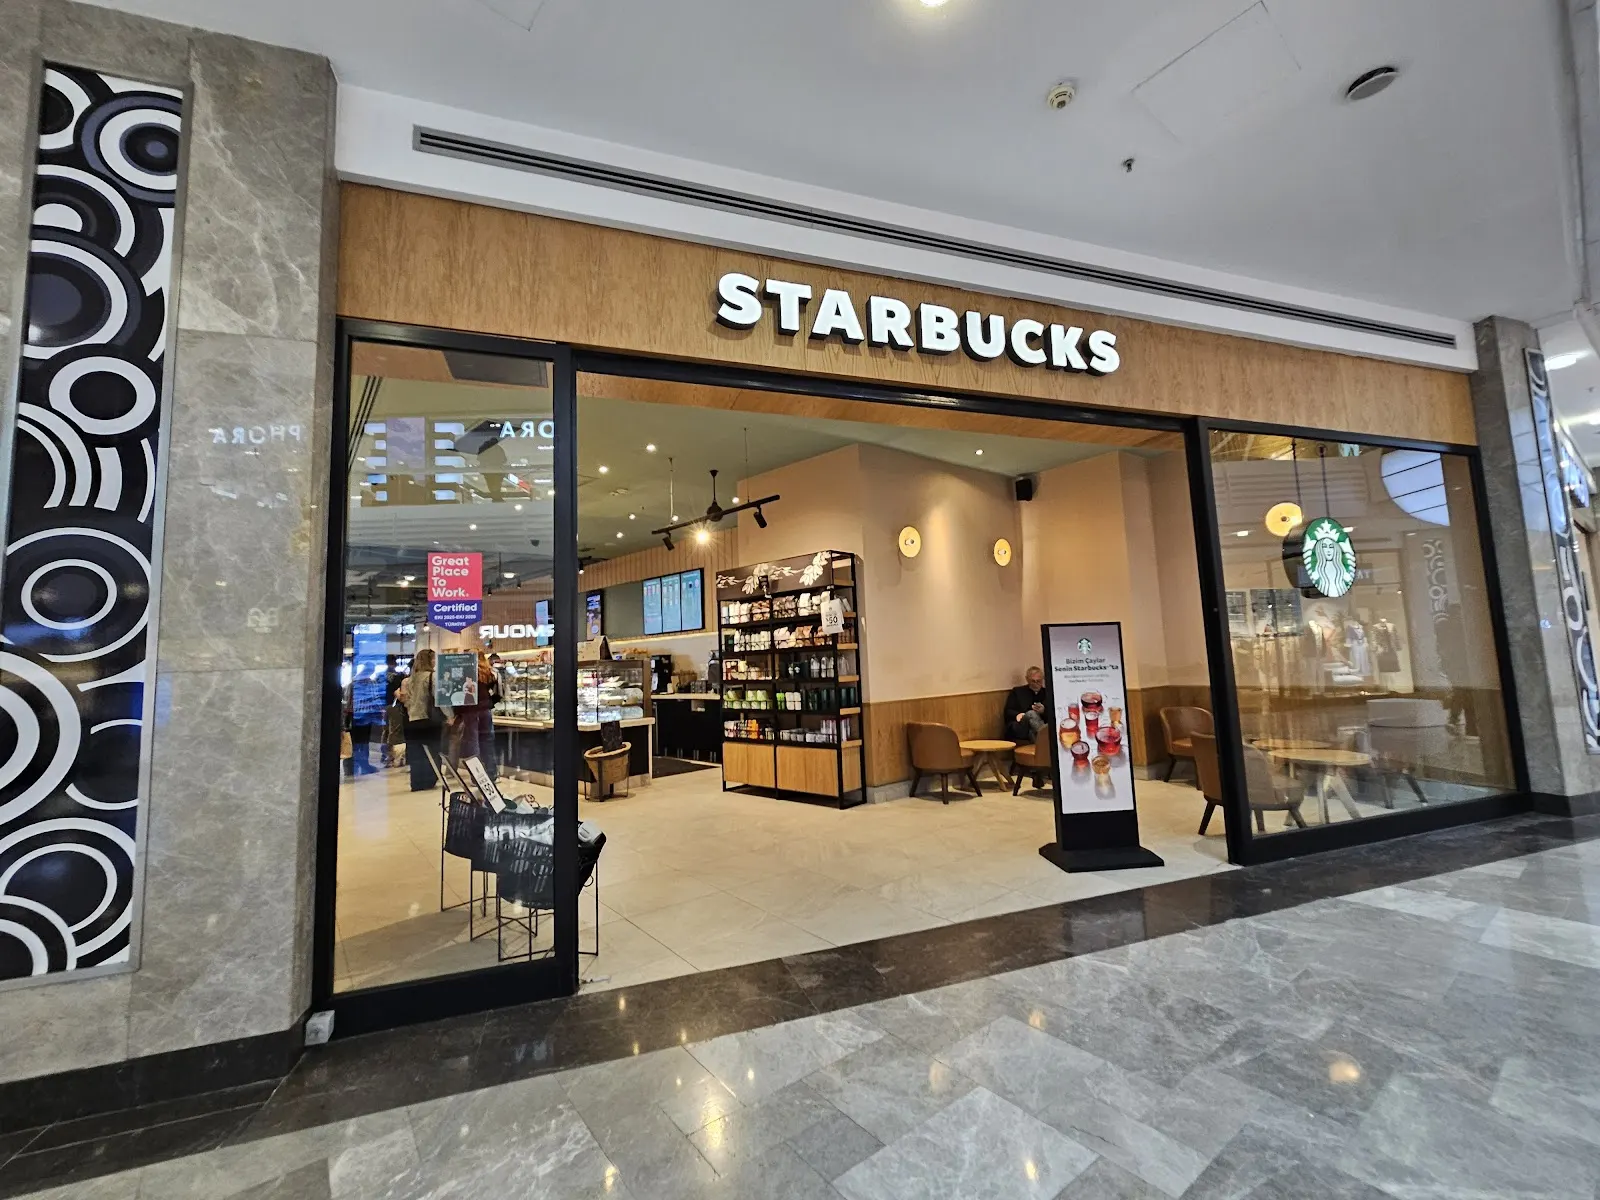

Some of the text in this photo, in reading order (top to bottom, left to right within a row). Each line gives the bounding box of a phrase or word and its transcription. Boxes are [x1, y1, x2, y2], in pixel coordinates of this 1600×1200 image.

[716, 272, 1121, 375] STARBUCKS
[432, 556, 469, 566] Great
[432, 566, 469, 576] Place
[432, 577, 447, 587] To
[433, 603, 478, 612] Certified
[1084, 657, 1106, 665] Çaylar
